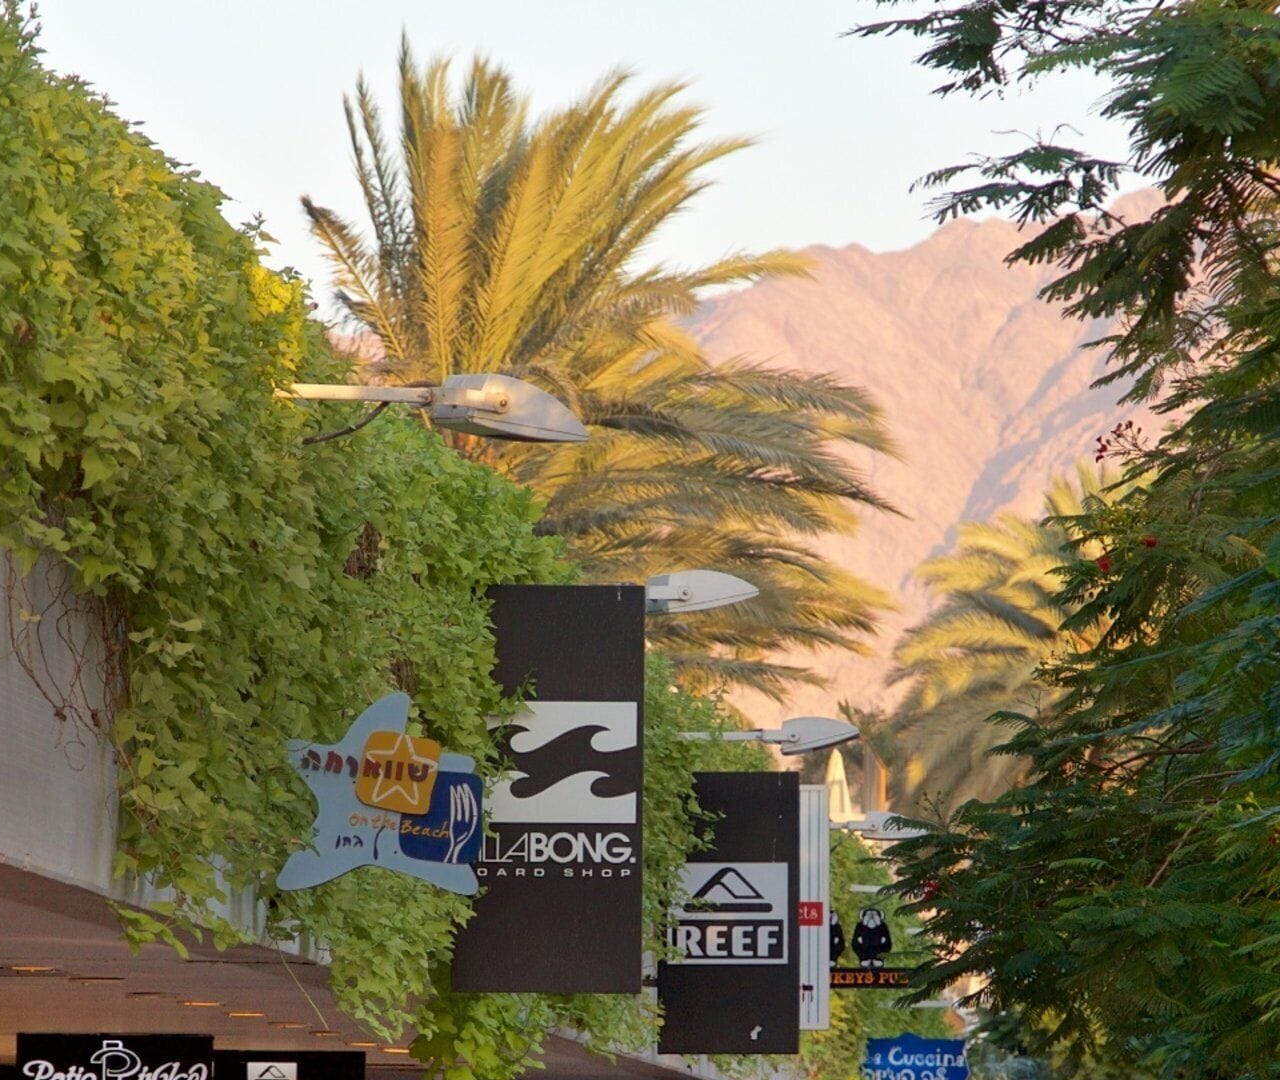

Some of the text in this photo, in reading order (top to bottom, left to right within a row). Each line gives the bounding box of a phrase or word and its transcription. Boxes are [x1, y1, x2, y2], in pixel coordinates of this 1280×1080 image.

[399, 820, 450, 839] Beach
[479, 832, 637, 863] LLABONG.
[477, 868, 631, 877] OARD SHOP
[679, 924, 781, 958] REEF
[887, 1046, 965, 1067] Cuccina
